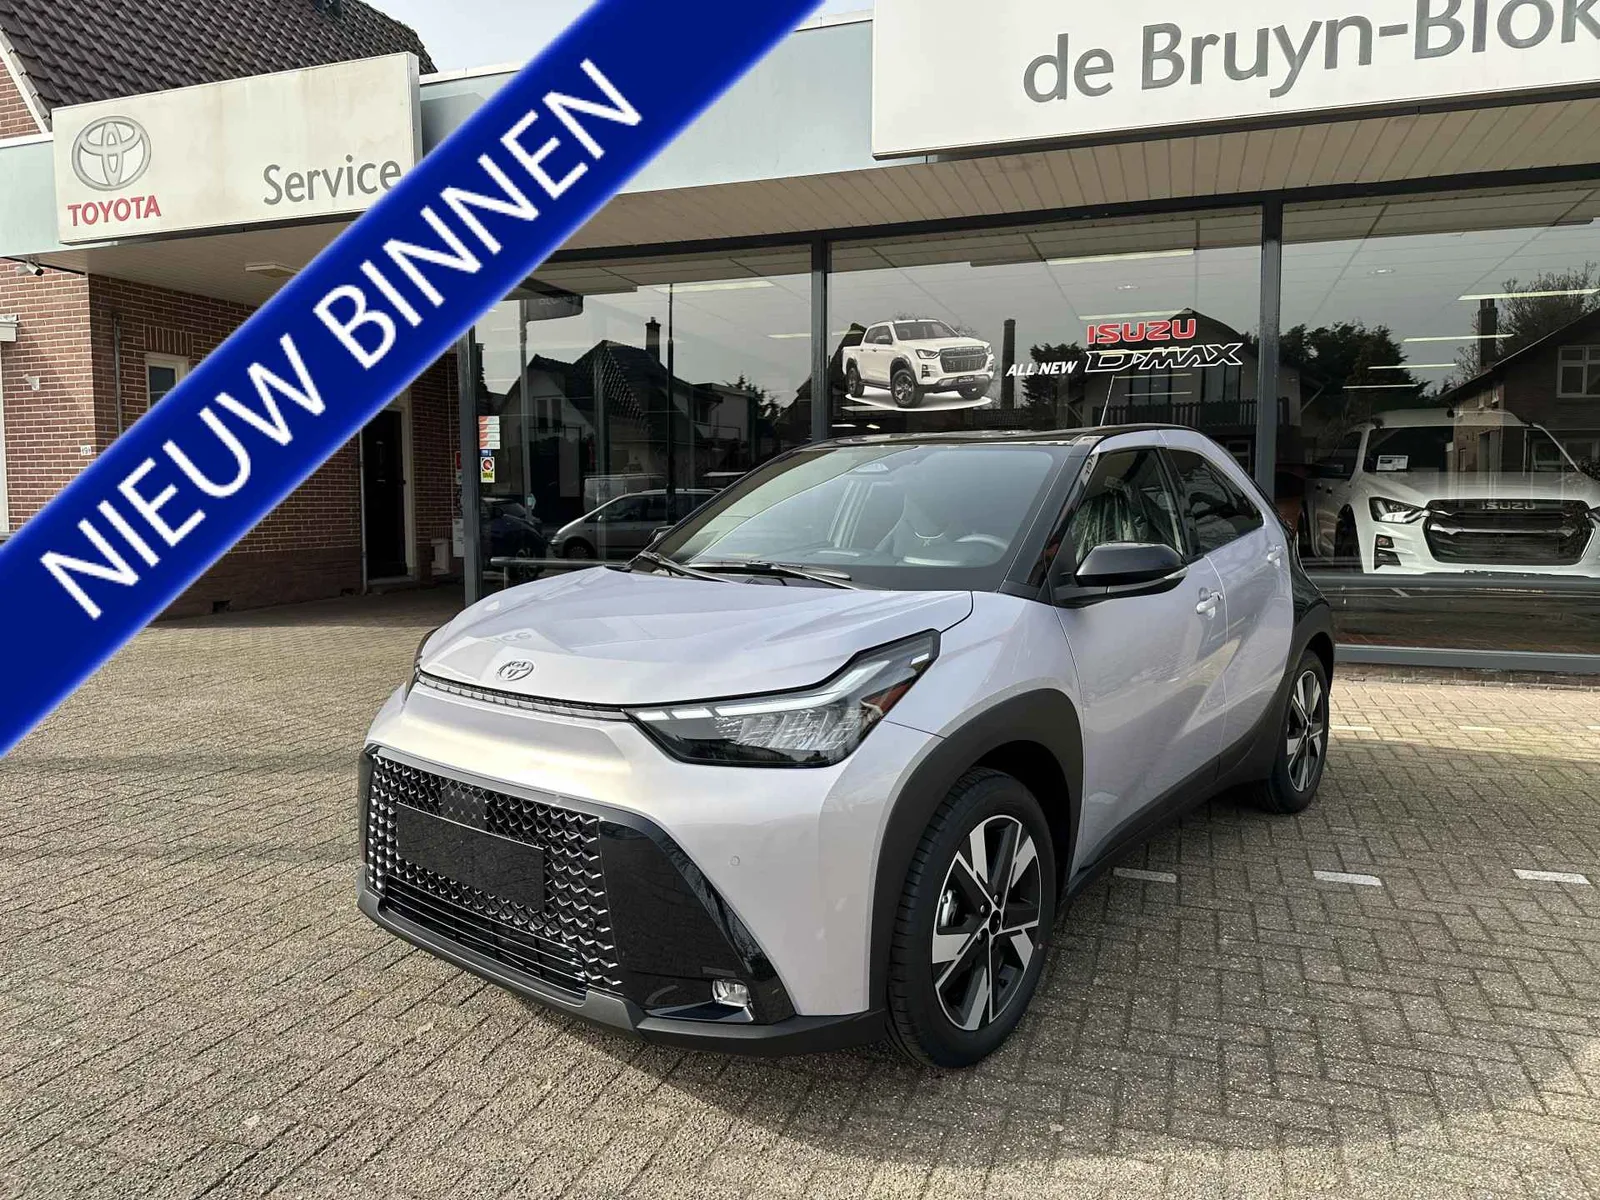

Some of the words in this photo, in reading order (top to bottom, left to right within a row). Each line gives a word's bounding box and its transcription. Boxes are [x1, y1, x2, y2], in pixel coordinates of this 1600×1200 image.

[1023, 33, 1114, 103] de
[1141, 0, 1600, 99] Bruyn-Blok
[263, 154, 402, 206] Service
[67, 195, 162, 226] TOYOTA
[1086, 318, 1197, 345] ISUZU
[1005, 362, 1036, 378] ALL
[1038, 360, 1079, 376] NEW
[1480, 501, 1537, 511] ISUZU
